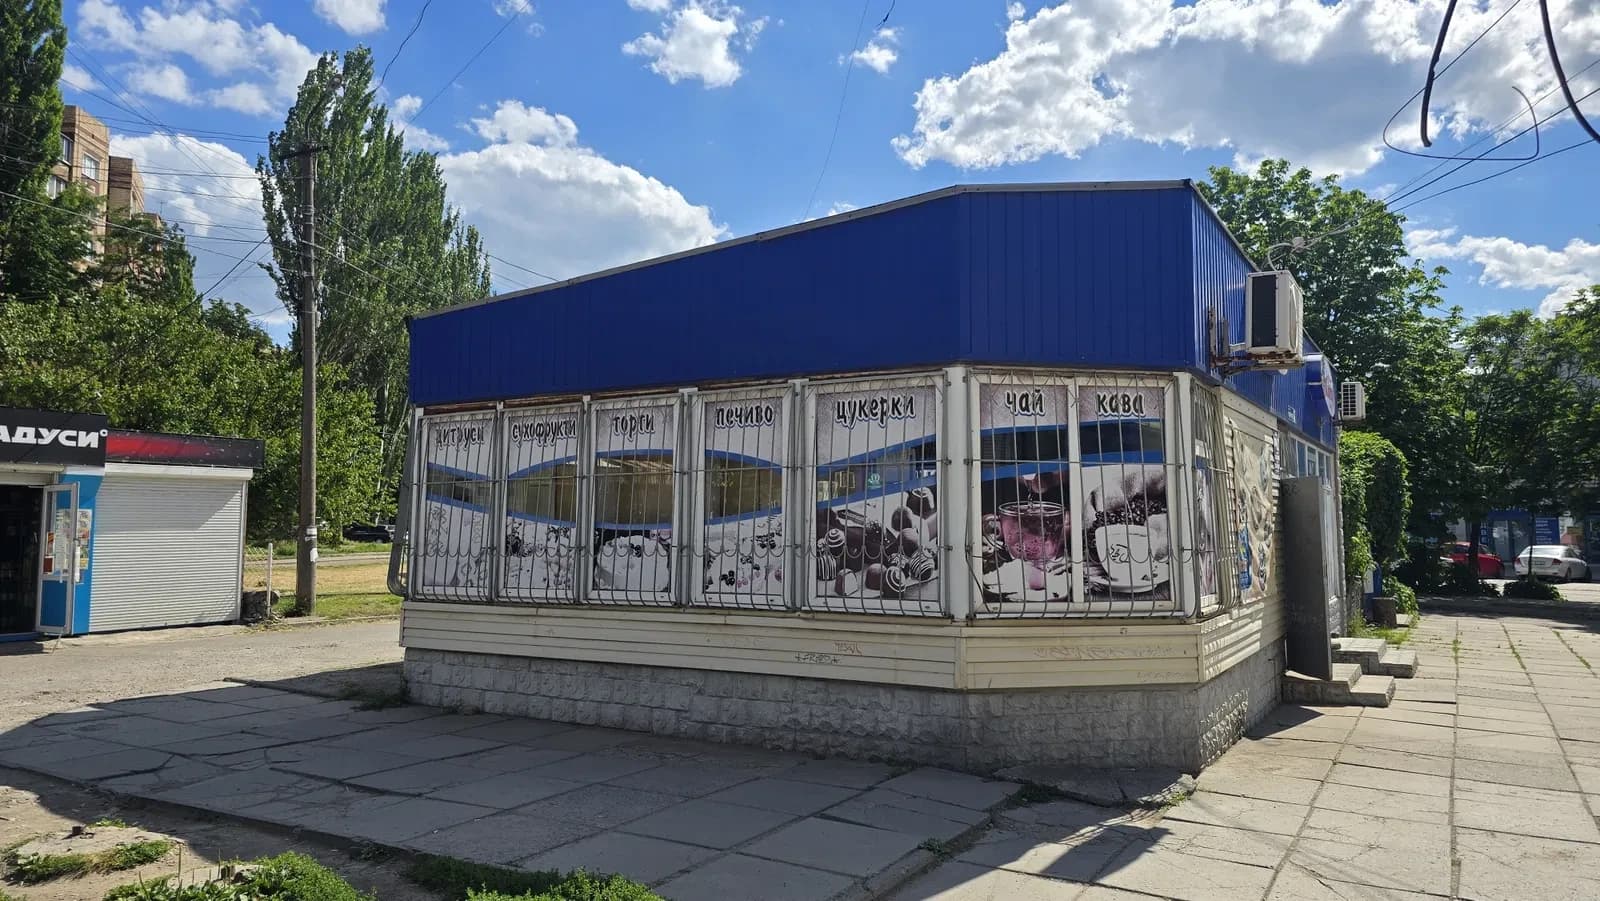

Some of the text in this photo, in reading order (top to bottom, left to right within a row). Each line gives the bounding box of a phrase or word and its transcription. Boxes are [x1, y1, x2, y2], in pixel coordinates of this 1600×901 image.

[836, 395, 916, 427] цукерки
[1005, 388, 1045, 415] чай
[1097, 393, 1145, 415] кава
[714, 404, 775, 427] печиво
